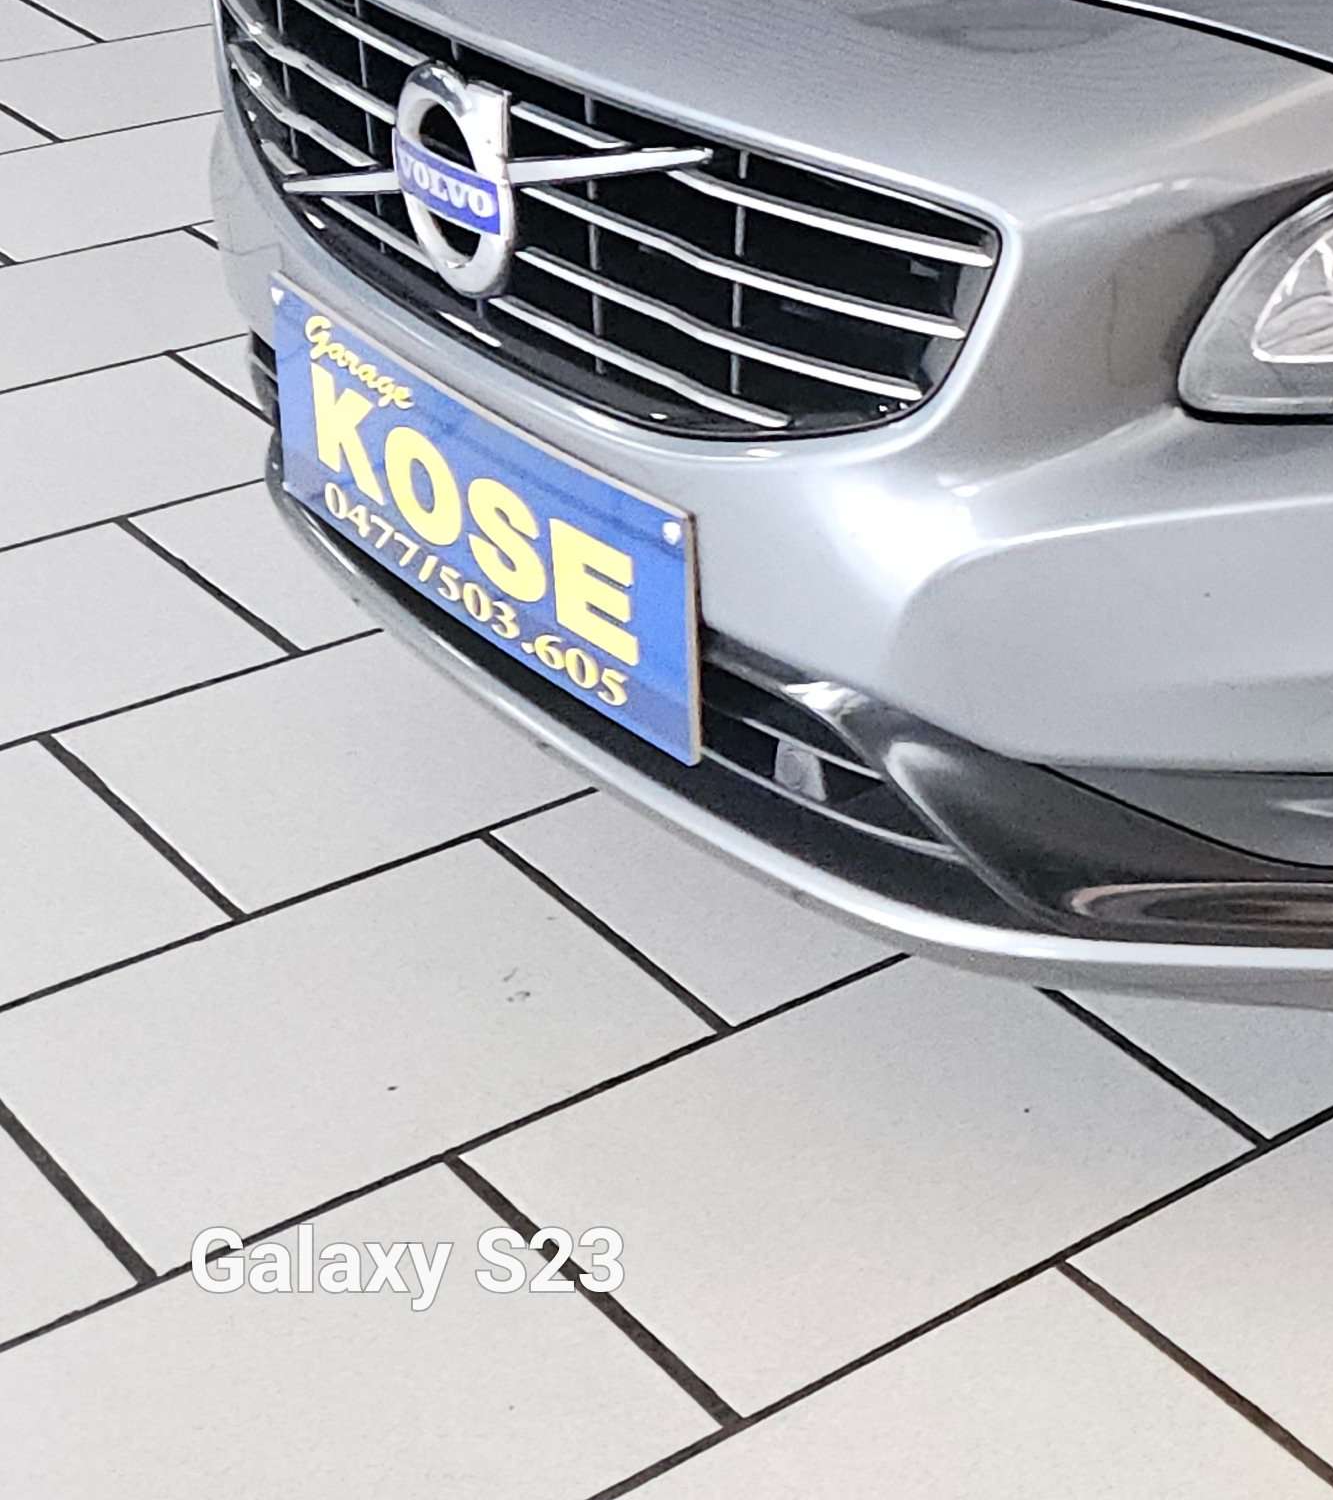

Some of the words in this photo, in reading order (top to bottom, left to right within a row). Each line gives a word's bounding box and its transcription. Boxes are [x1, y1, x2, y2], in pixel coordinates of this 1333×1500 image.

[401, 156, 498, 218] VOLVO
[304, 315, 416, 410] Garage
[310, 362, 639, 666] KOSE
